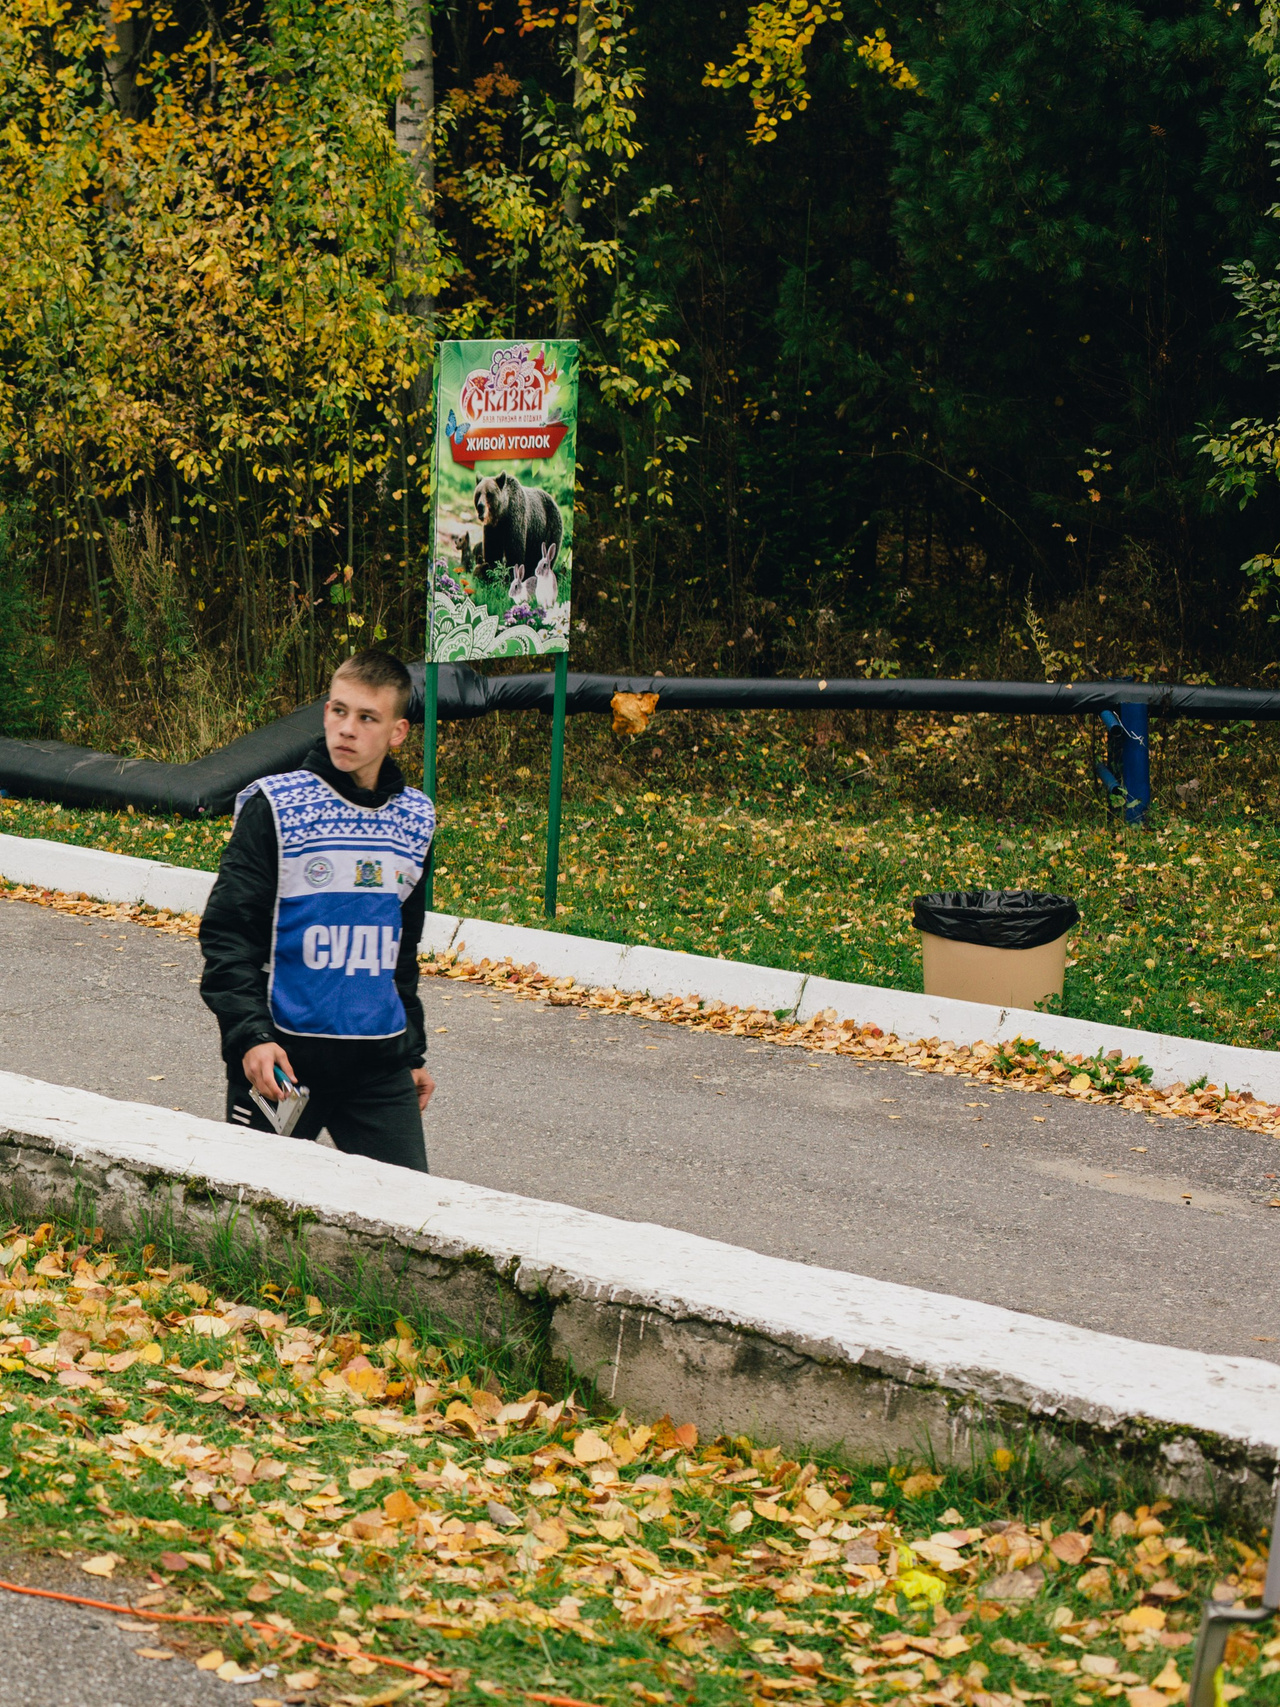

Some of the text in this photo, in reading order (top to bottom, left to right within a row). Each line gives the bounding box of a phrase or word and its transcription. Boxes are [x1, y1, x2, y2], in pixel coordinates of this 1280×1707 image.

[466, 434, 550, 451] ЖИВОЙ УГОЛОК
[302, 924, 402, 977] СУДЬ
